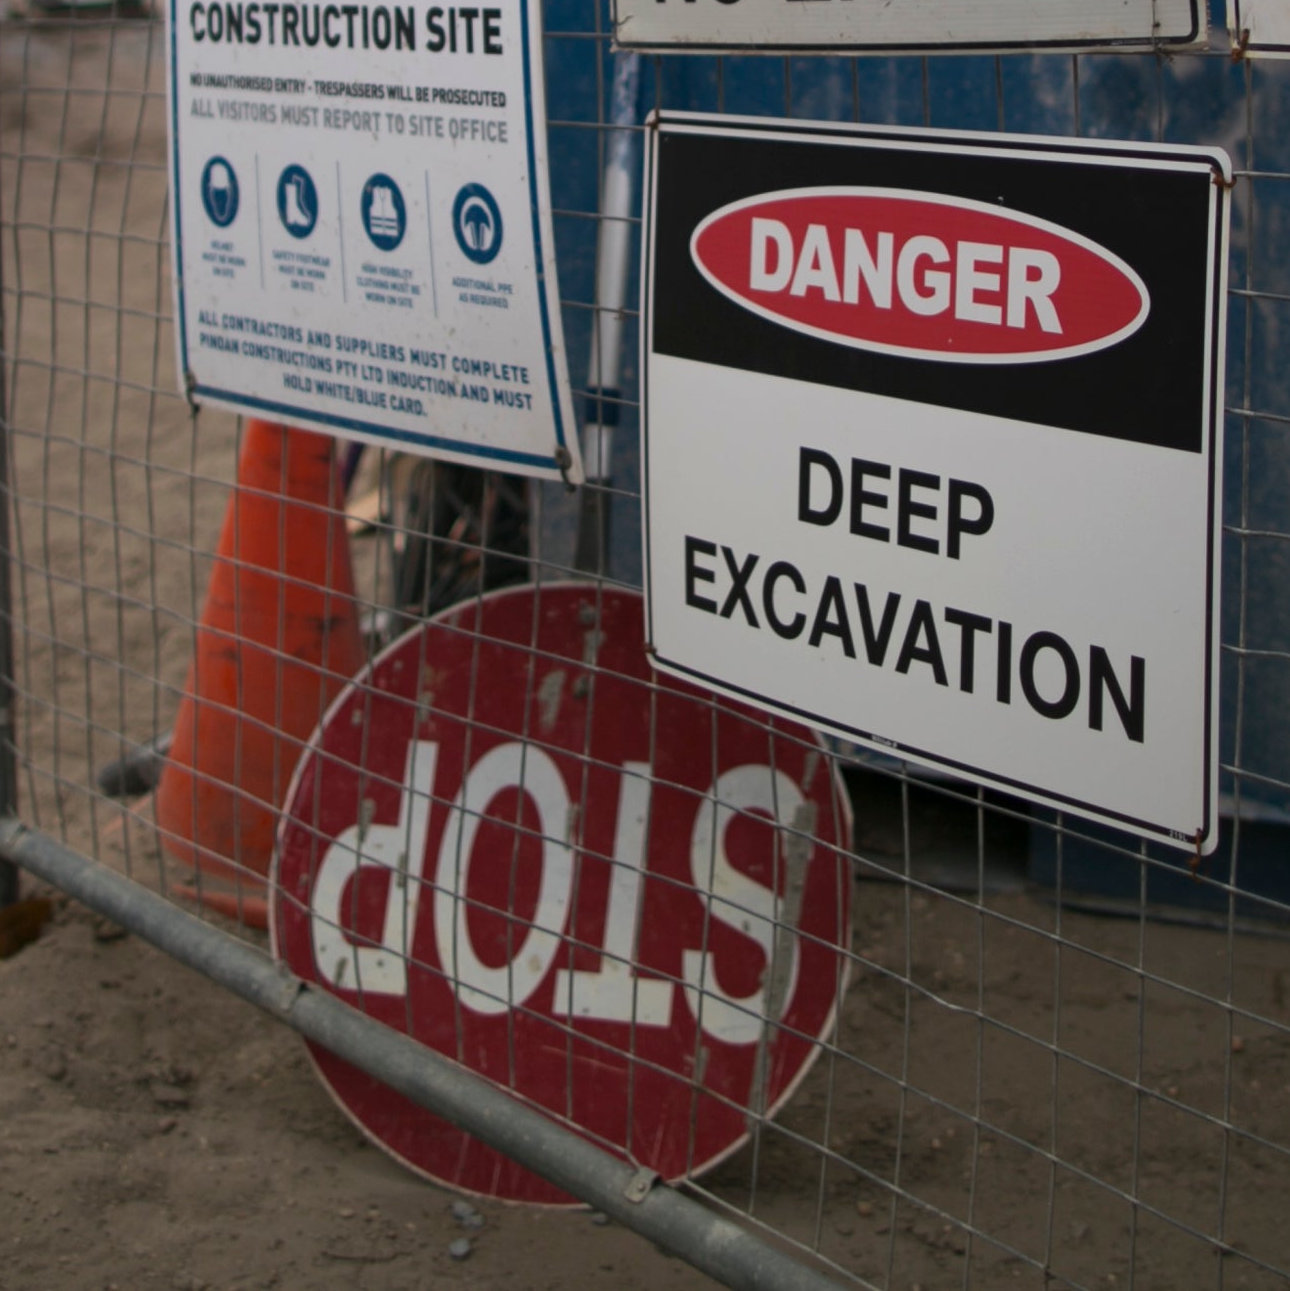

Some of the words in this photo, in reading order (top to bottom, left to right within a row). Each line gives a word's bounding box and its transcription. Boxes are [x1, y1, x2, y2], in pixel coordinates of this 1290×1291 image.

[190, 1, 416, 50] CONSTRUCTION
[425, 6, 503, 55] SITE
[190, 73, 202, 86] NO
[203, 73, 273, 92] UNAUTHORISED
[275, 77, 306, 93] ENTRY
[314, 80, 385, 99] TRESPASSERS
[386, 85, 412, 101] WILL
[415, 86, 429, 102] BE
[432, 87, 506, 107] PROSECUTED
[190, 97, 214, 118] ALL
[217, 98, 277, 124] VISITORS
[281, 105, 318, 128] MUST
[323, 107, 381, 132] REPORT
[385, 112, 405, 134] TO
[409, 115, 444, 138] SITE
[449, 118, 508, 143] OFFICE
[452, 276, 496, 293] ADDITIONAL
[470, 294, 509, 310] REQUIRED
[749, 217, 1063, 334] DANGER
[199, 310, 218, 327] ALL
[222, 313, 303, 344] CONTRACTORS
[307, 329, 331, 349] AND
[336, 334, 405, 362] SUPPLIERS
[410, 347, 447, 370] MUST
[452, 355, 530, 384] COMPLETE
[200, 331, 239, 354] PINDAN
[242, 340, 333, 373] CONSTRUCTIONS
[336, 358, 358, 379] PTY
[361, 365, 383, 384] LTD
[387, 368, 457, 397] INDUCTION
[460, 384, 489, 404] AND
[493, 388, 532, 411] MUST
[283, 372, 311, 393] HOLD
[315, 380, 386, 409] WHITE/BLUE
[390, 394, 427, 416] CARD.
[798, 446, 995, 560] DEEP
[685, 535, 1146, 744] EXCAVATION
[313, 740, 813, 1045] STOP
